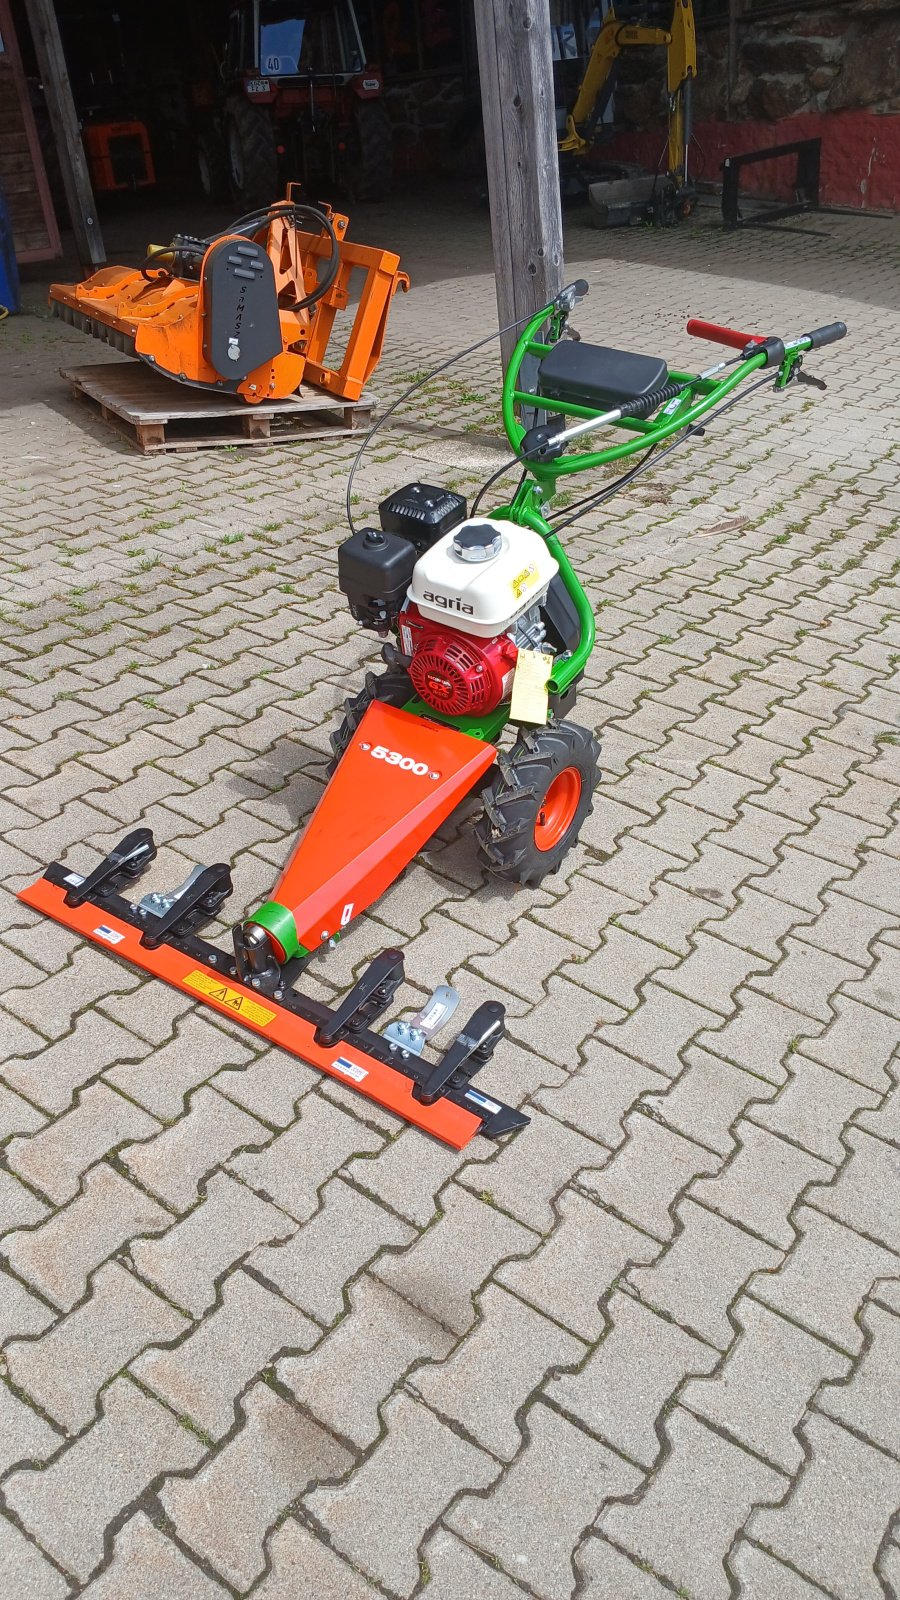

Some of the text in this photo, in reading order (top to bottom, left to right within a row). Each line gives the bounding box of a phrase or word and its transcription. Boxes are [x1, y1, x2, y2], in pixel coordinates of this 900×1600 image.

[268, 57, 280, 71] 40
[423, 590, 474, 615] agria
[370, 745, 429, 776] 5300
